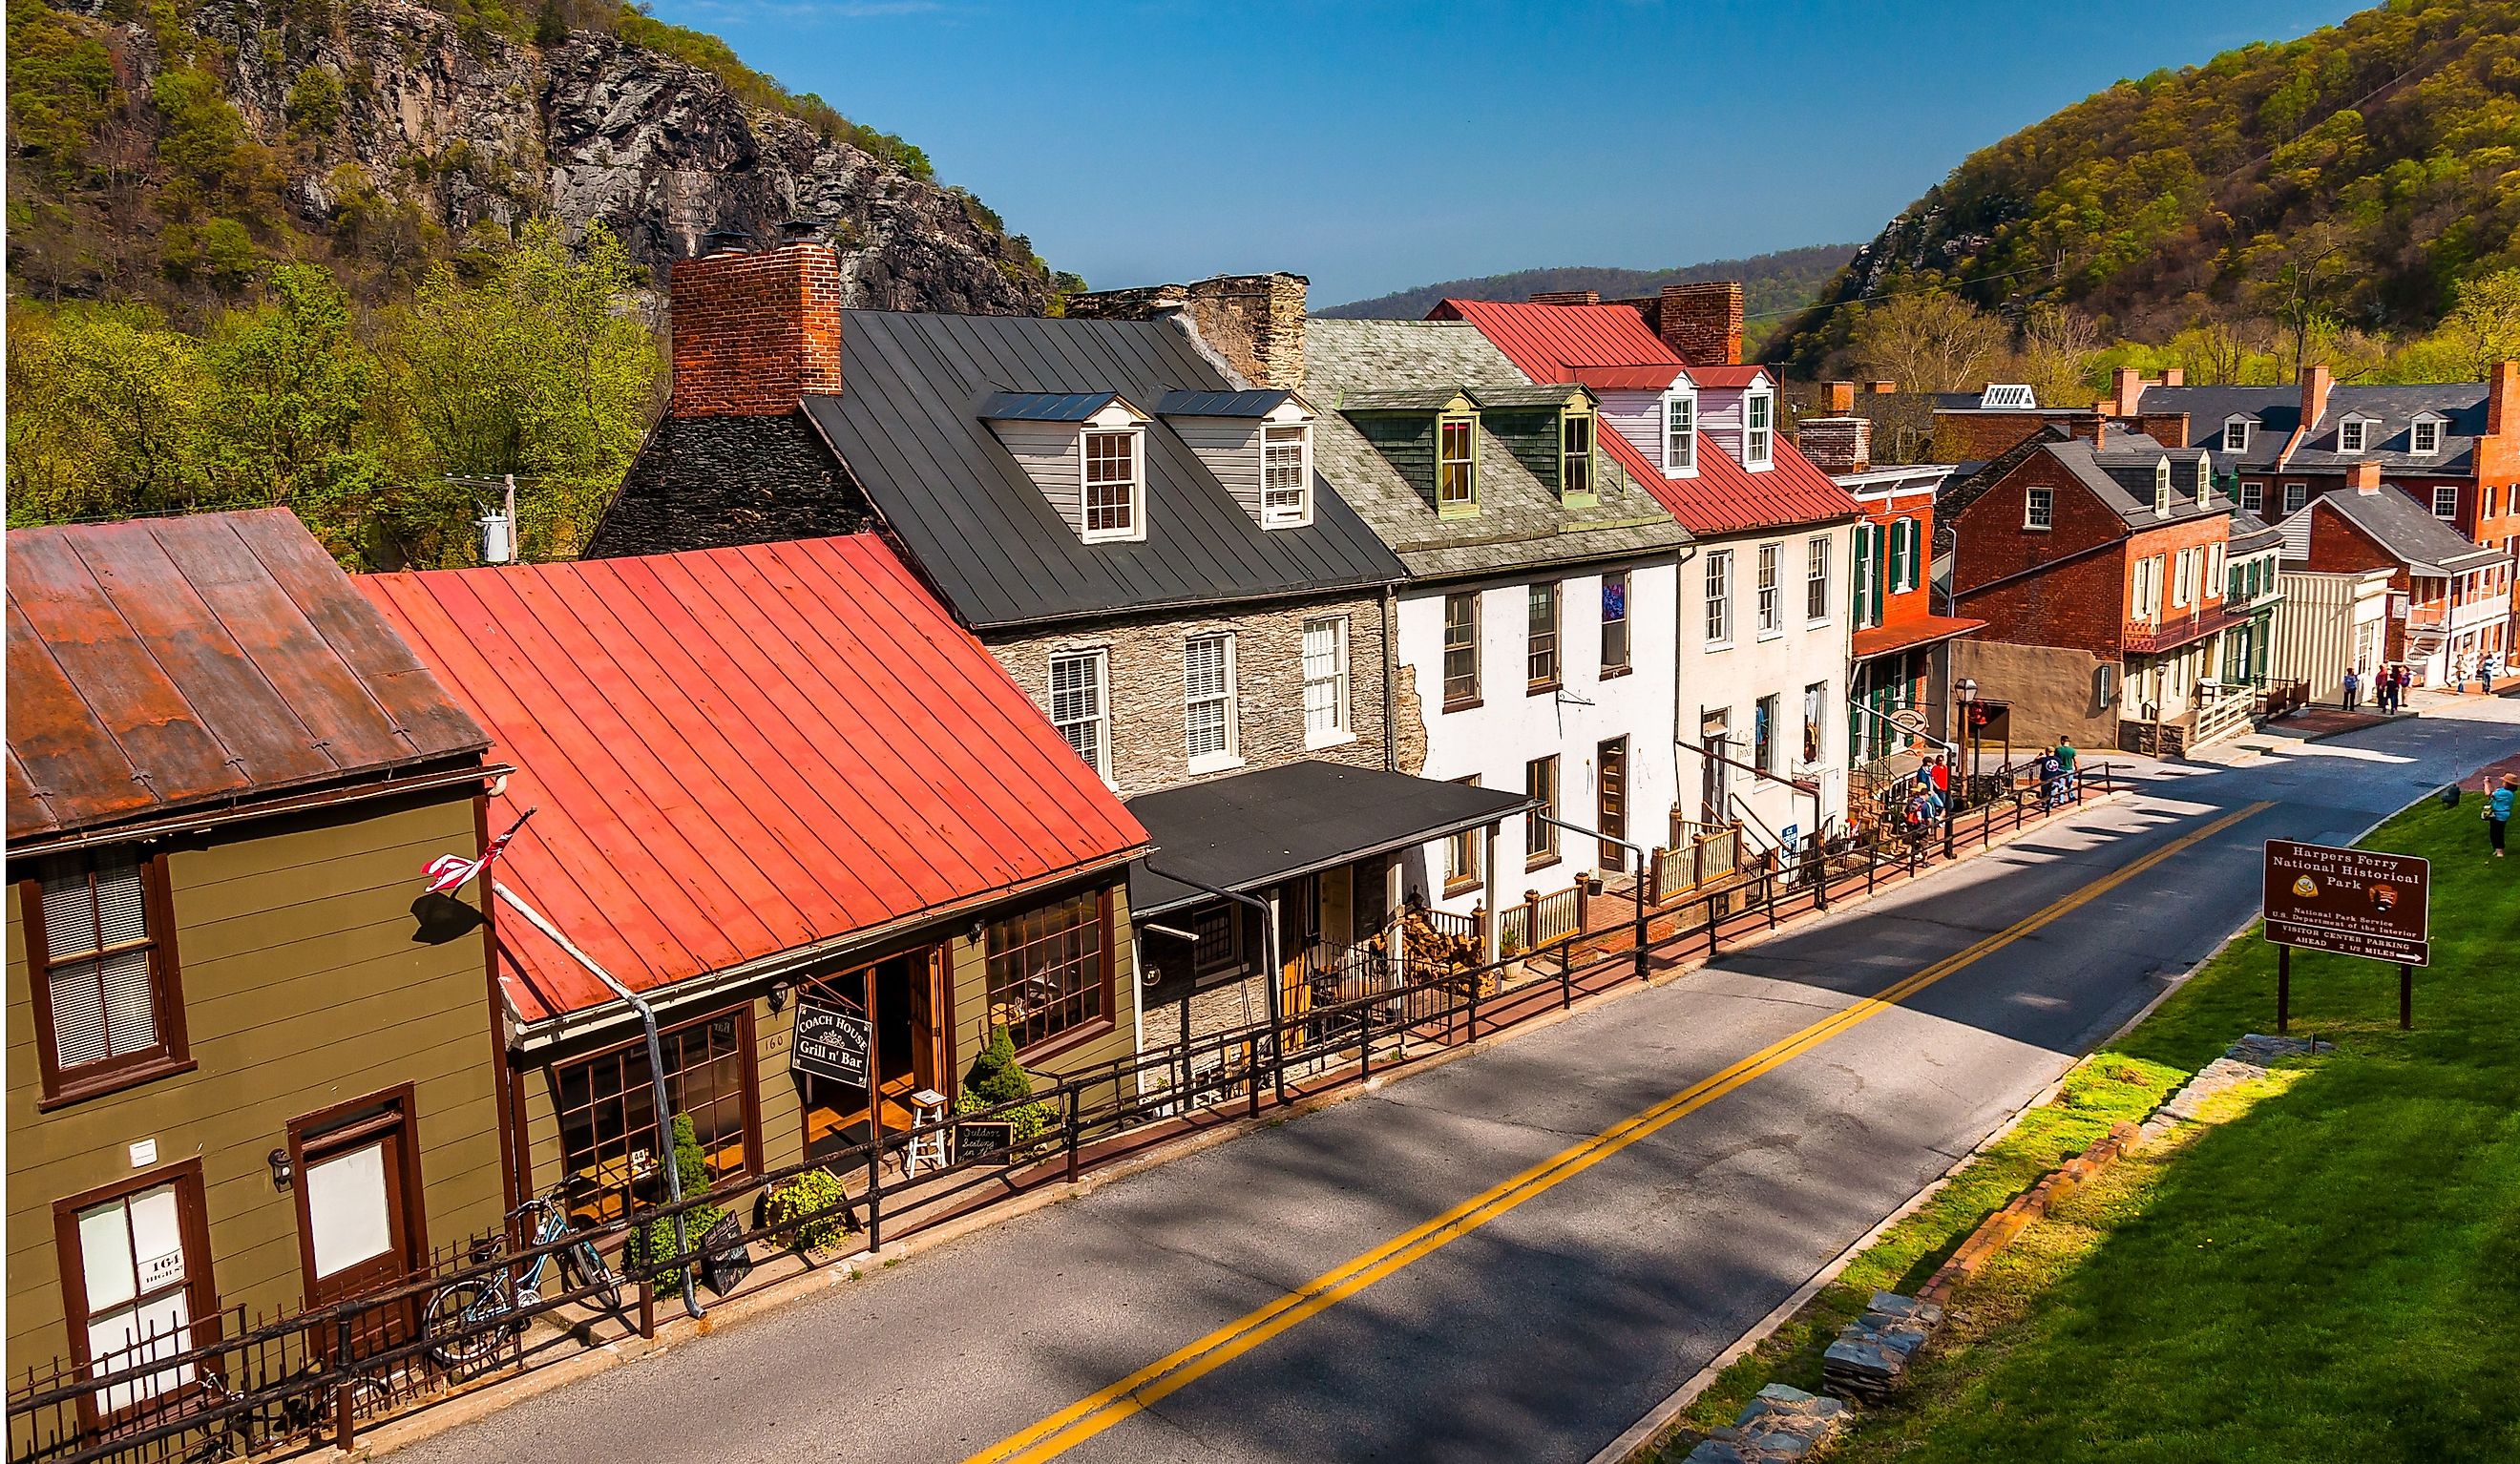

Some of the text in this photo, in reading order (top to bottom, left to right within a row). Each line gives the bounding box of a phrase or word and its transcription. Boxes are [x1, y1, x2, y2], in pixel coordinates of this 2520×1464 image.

[2293, 846, 2398, 870] Harpers Ferry
[2273, 856, 2419, 885] National Historical
[2326, 876, 2362, 890] Park
[2272, 910, 2288, 919] U.S.
[2292, 913, 2345, 930] Department
[2361, 924, 2376, 932] the
[2379, 927, 2418, 938] Interior
[2294, 907, 2393, 928] National Park Service
[2281, 924, 2410, 952] VISITOR CENTER PARKING
[2295, 936, 2327, 948] AHEAD
[2364, 946, 2396, 957] MILES
[764, 1035, 784, 1052] 160
[799, 1014, 868, 1051] COACH HOUSE
[800, 1040, 862, 1069] Grill n' Bar
[154, 1254, 179, 1272] 164
